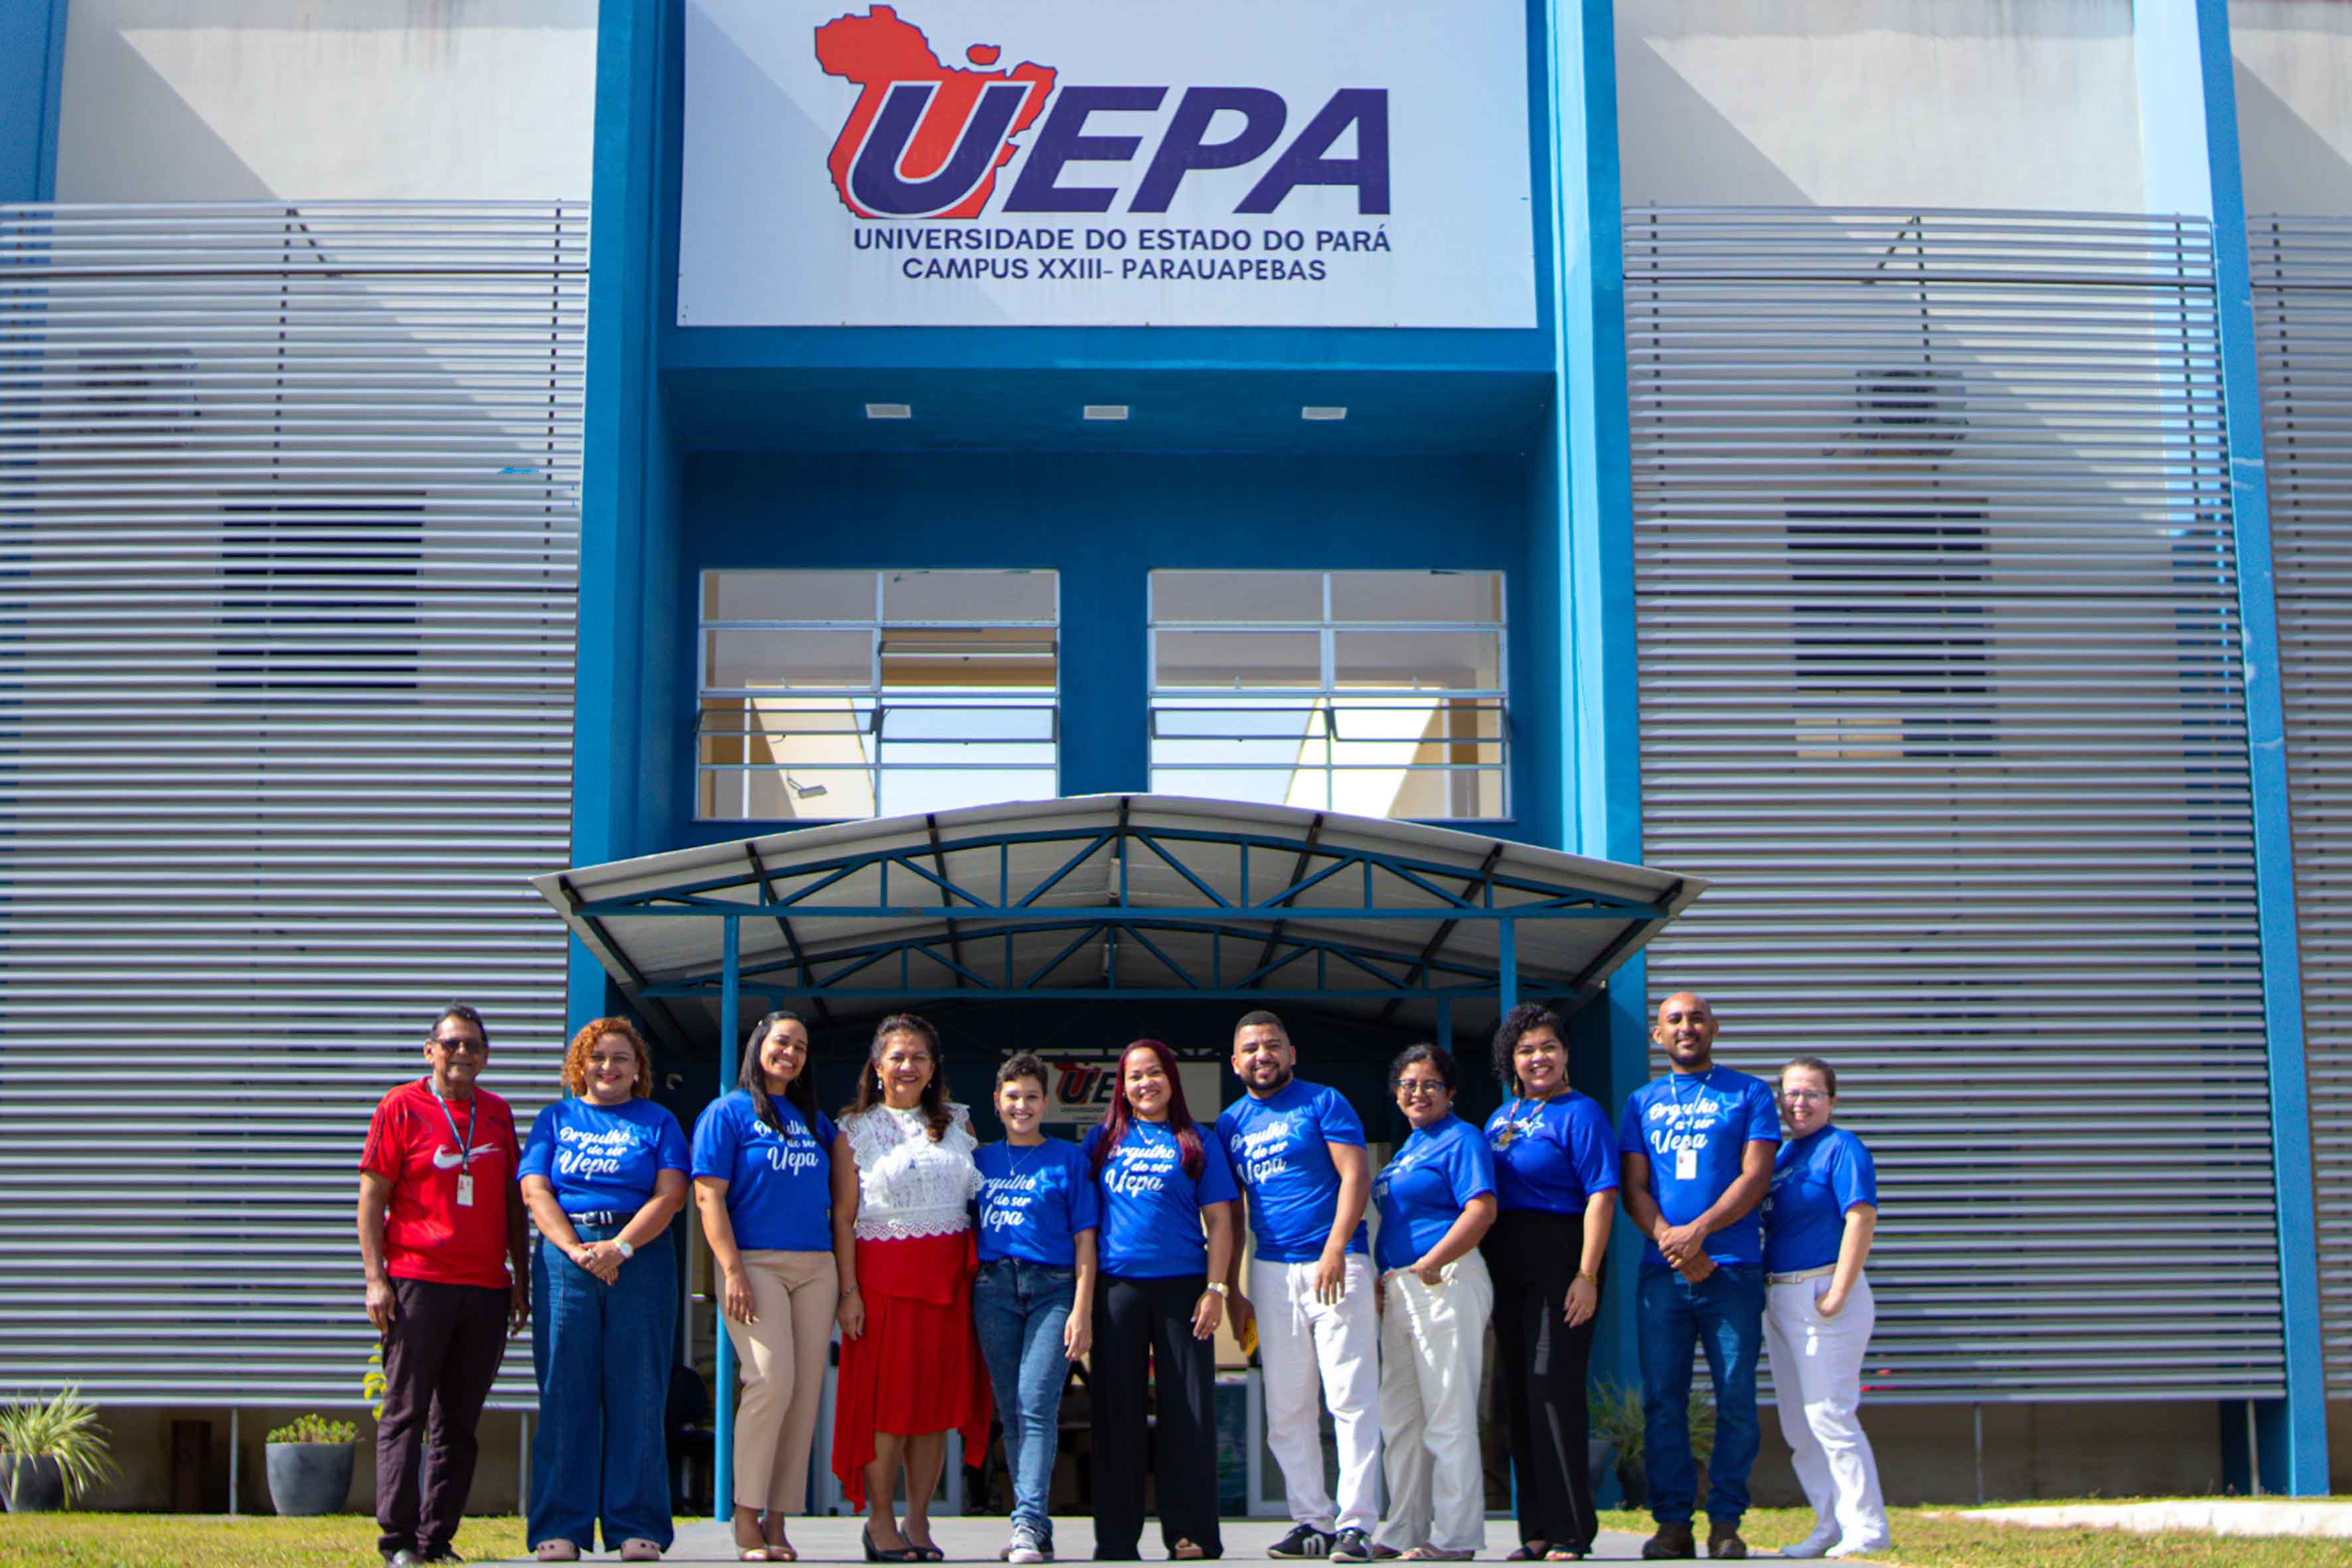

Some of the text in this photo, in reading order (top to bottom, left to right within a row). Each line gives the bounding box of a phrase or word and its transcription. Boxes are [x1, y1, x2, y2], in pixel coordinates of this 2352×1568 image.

[850, 84, 1391, 216] UEPA
[854, 223, 1392, 252] UNIVERSIDADE DO ESTADO DO PARÁ
[902, 257, 1029, 279] CAMPUS
[1123, 258, 1326, 281] PARAUAPEBAS
[1061, 1071, 1117, 1105] UE
[1693, 1119, 1716, 1129] ser
[560, 1126, 630, 1150] Orgulho
[586, 1144, 627, 1156] de ser
[801, 1139, 817, 1148] ser
[1231, 1121, 1289, 1157] Orgulho
[1252, 1140, 1289, 1160] de ser
[560, 1150, 620, 1180] Uepa
[767, 1146, 819, 1176] Uepa
[1131, 1160, 1173, 1174] de ser
[1236, 1157, 1287, 1185] Uepa
[983, 1174, 1036, 1199] rgulho
[1105, 1168, 1164, 1198] Uepa
[992, 1192, 1032, 1207] de ser
